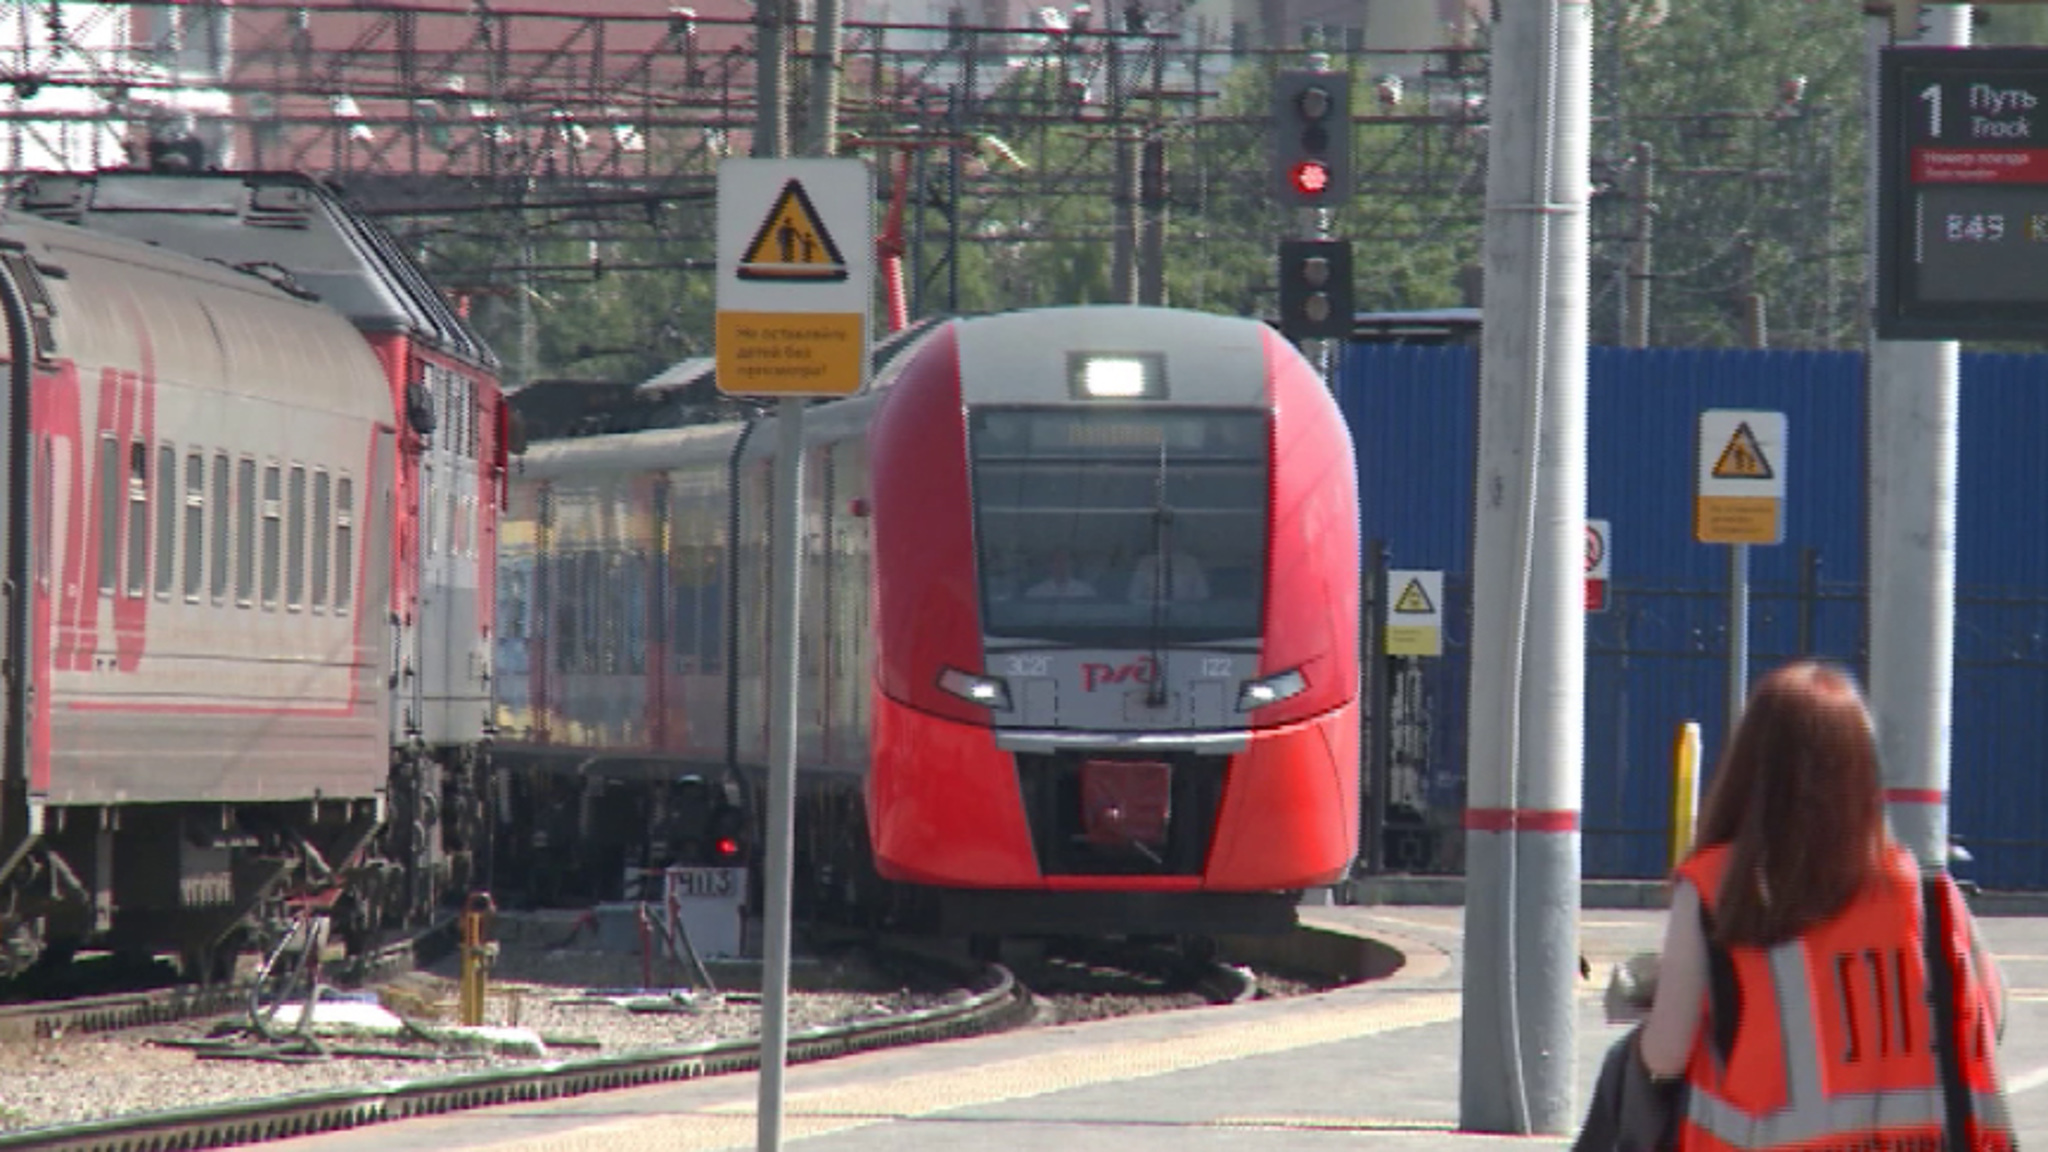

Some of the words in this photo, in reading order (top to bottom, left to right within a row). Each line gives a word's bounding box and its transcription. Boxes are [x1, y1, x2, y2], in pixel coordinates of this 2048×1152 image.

[1922, 84, 1942, 137] 1
[1969, 83, 2038, 114] Путь
[1971, 115, 2031, 137] Track
